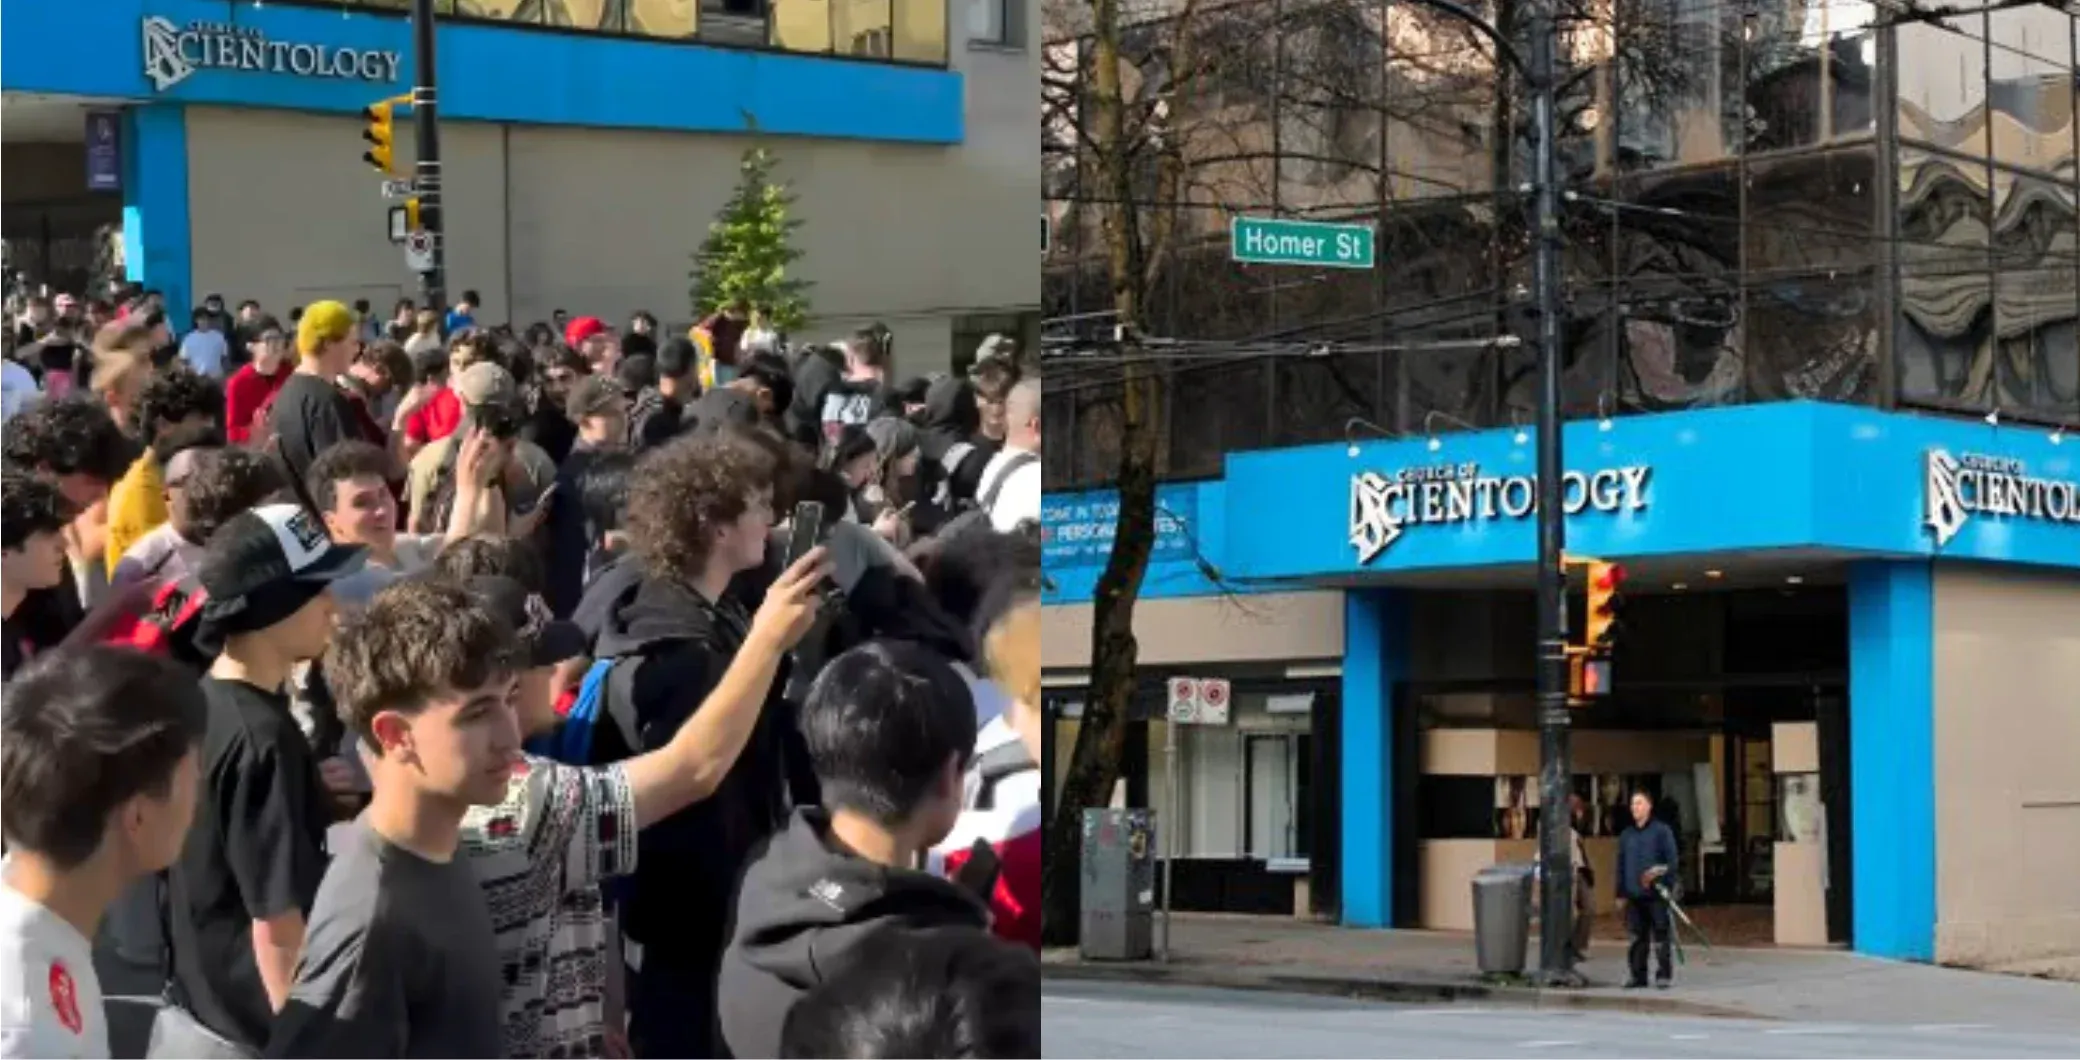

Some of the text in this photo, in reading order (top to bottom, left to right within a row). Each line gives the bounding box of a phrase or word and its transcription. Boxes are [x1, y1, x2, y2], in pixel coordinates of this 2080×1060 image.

[1245, 227, 1361, 260] Homer St
[1350, 466, 1650, 564] SCIENTOOGY
